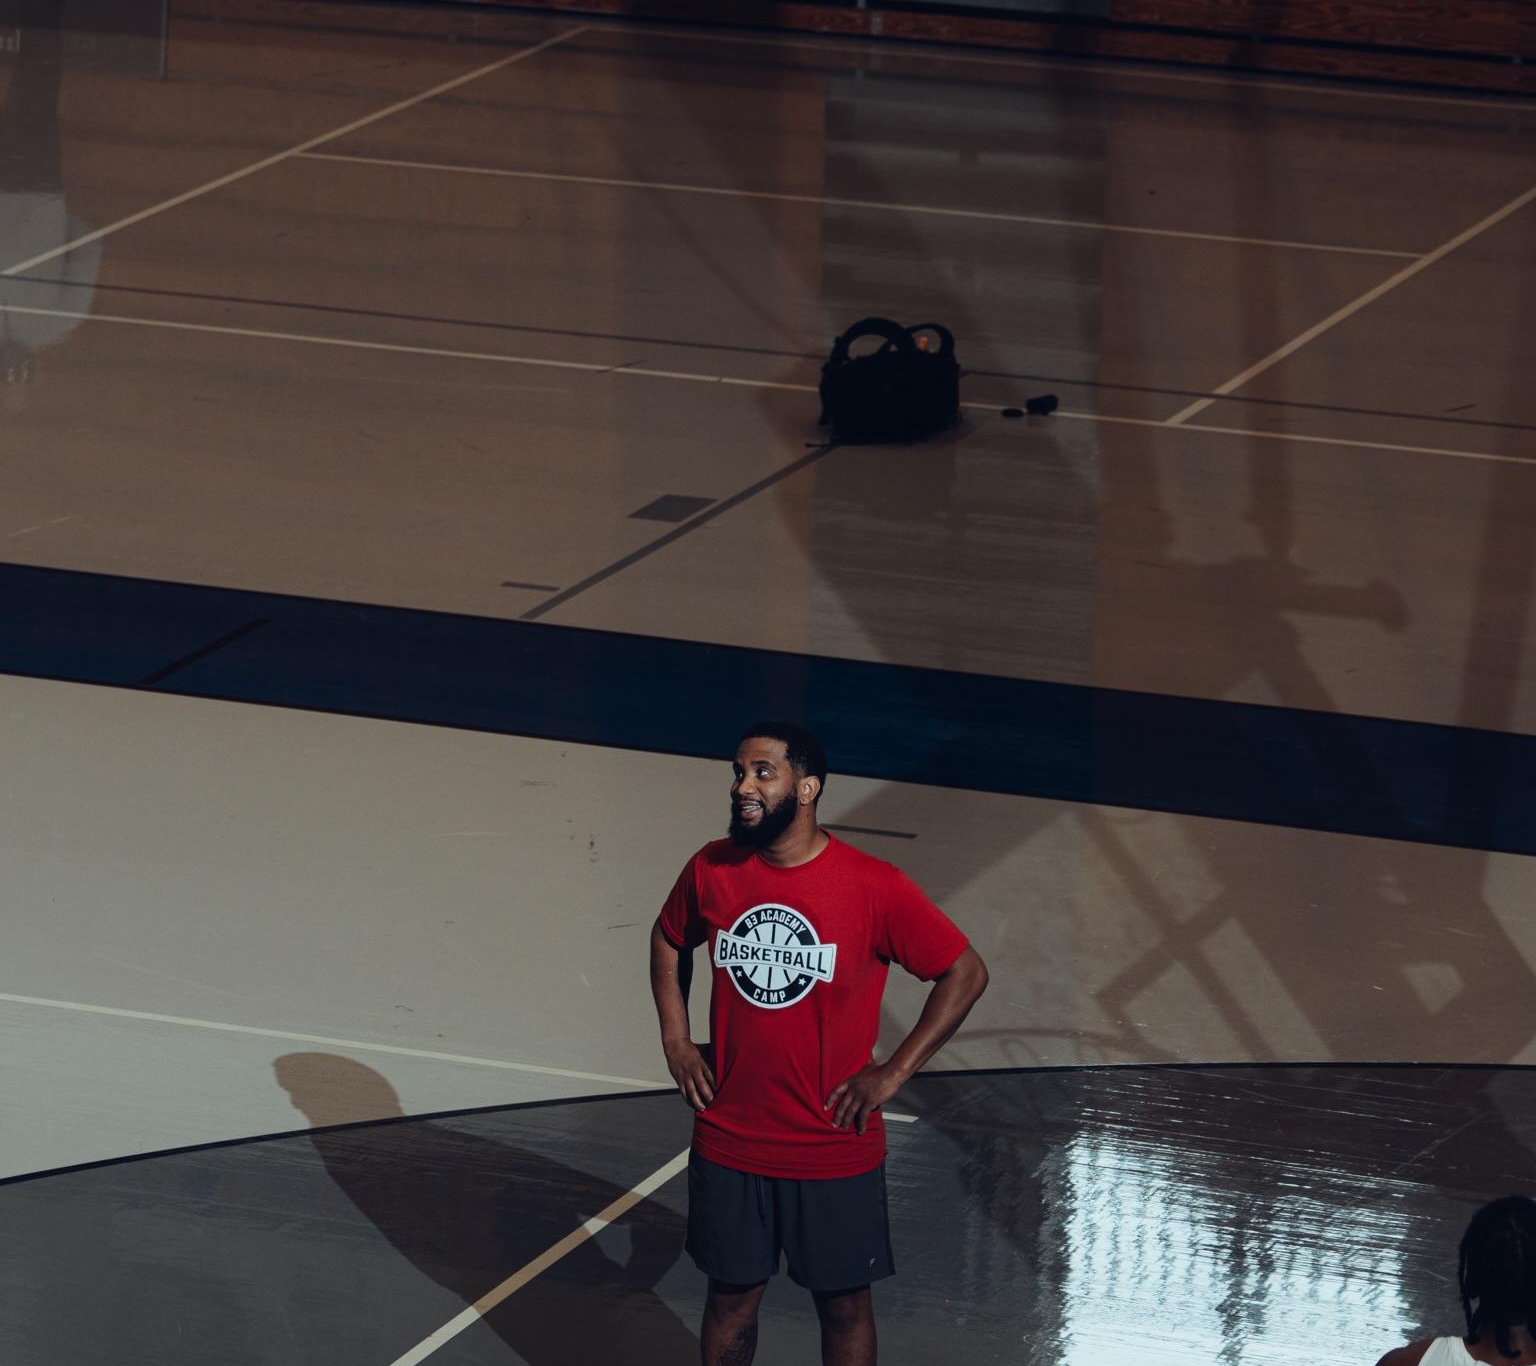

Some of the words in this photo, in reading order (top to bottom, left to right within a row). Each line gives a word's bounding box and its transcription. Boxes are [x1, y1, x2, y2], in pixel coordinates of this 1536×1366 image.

[744, 915, 757, 930] B3
[760, 910, 807, 934] ACADEMY
[719, 938, 827, 974] BASKETBALL
[753, 988, 786, 1004] CAMP
